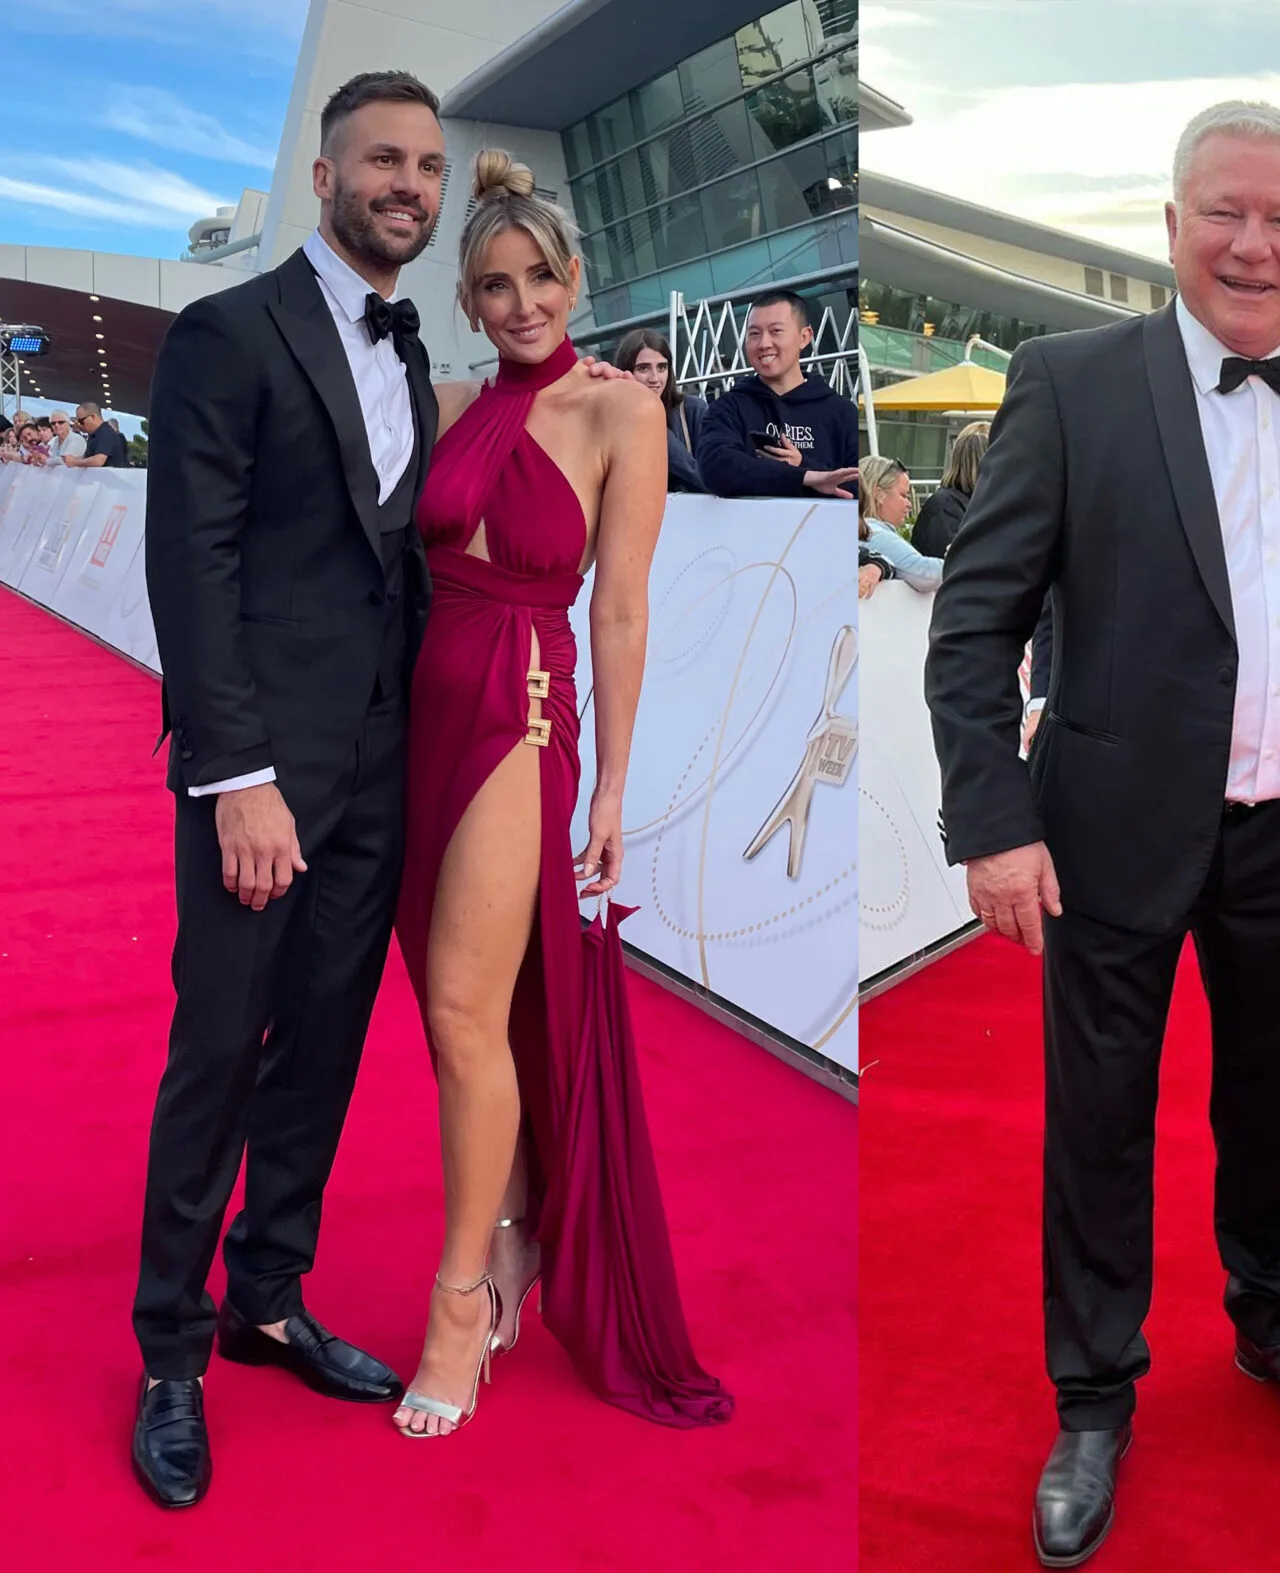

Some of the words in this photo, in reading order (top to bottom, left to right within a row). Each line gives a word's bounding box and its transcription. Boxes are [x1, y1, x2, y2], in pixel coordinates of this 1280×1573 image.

[765, 422, 815, 441] OVRIES.
[825, 732, 857, 762] TV
[818, 758, 846, 778] WEEK
